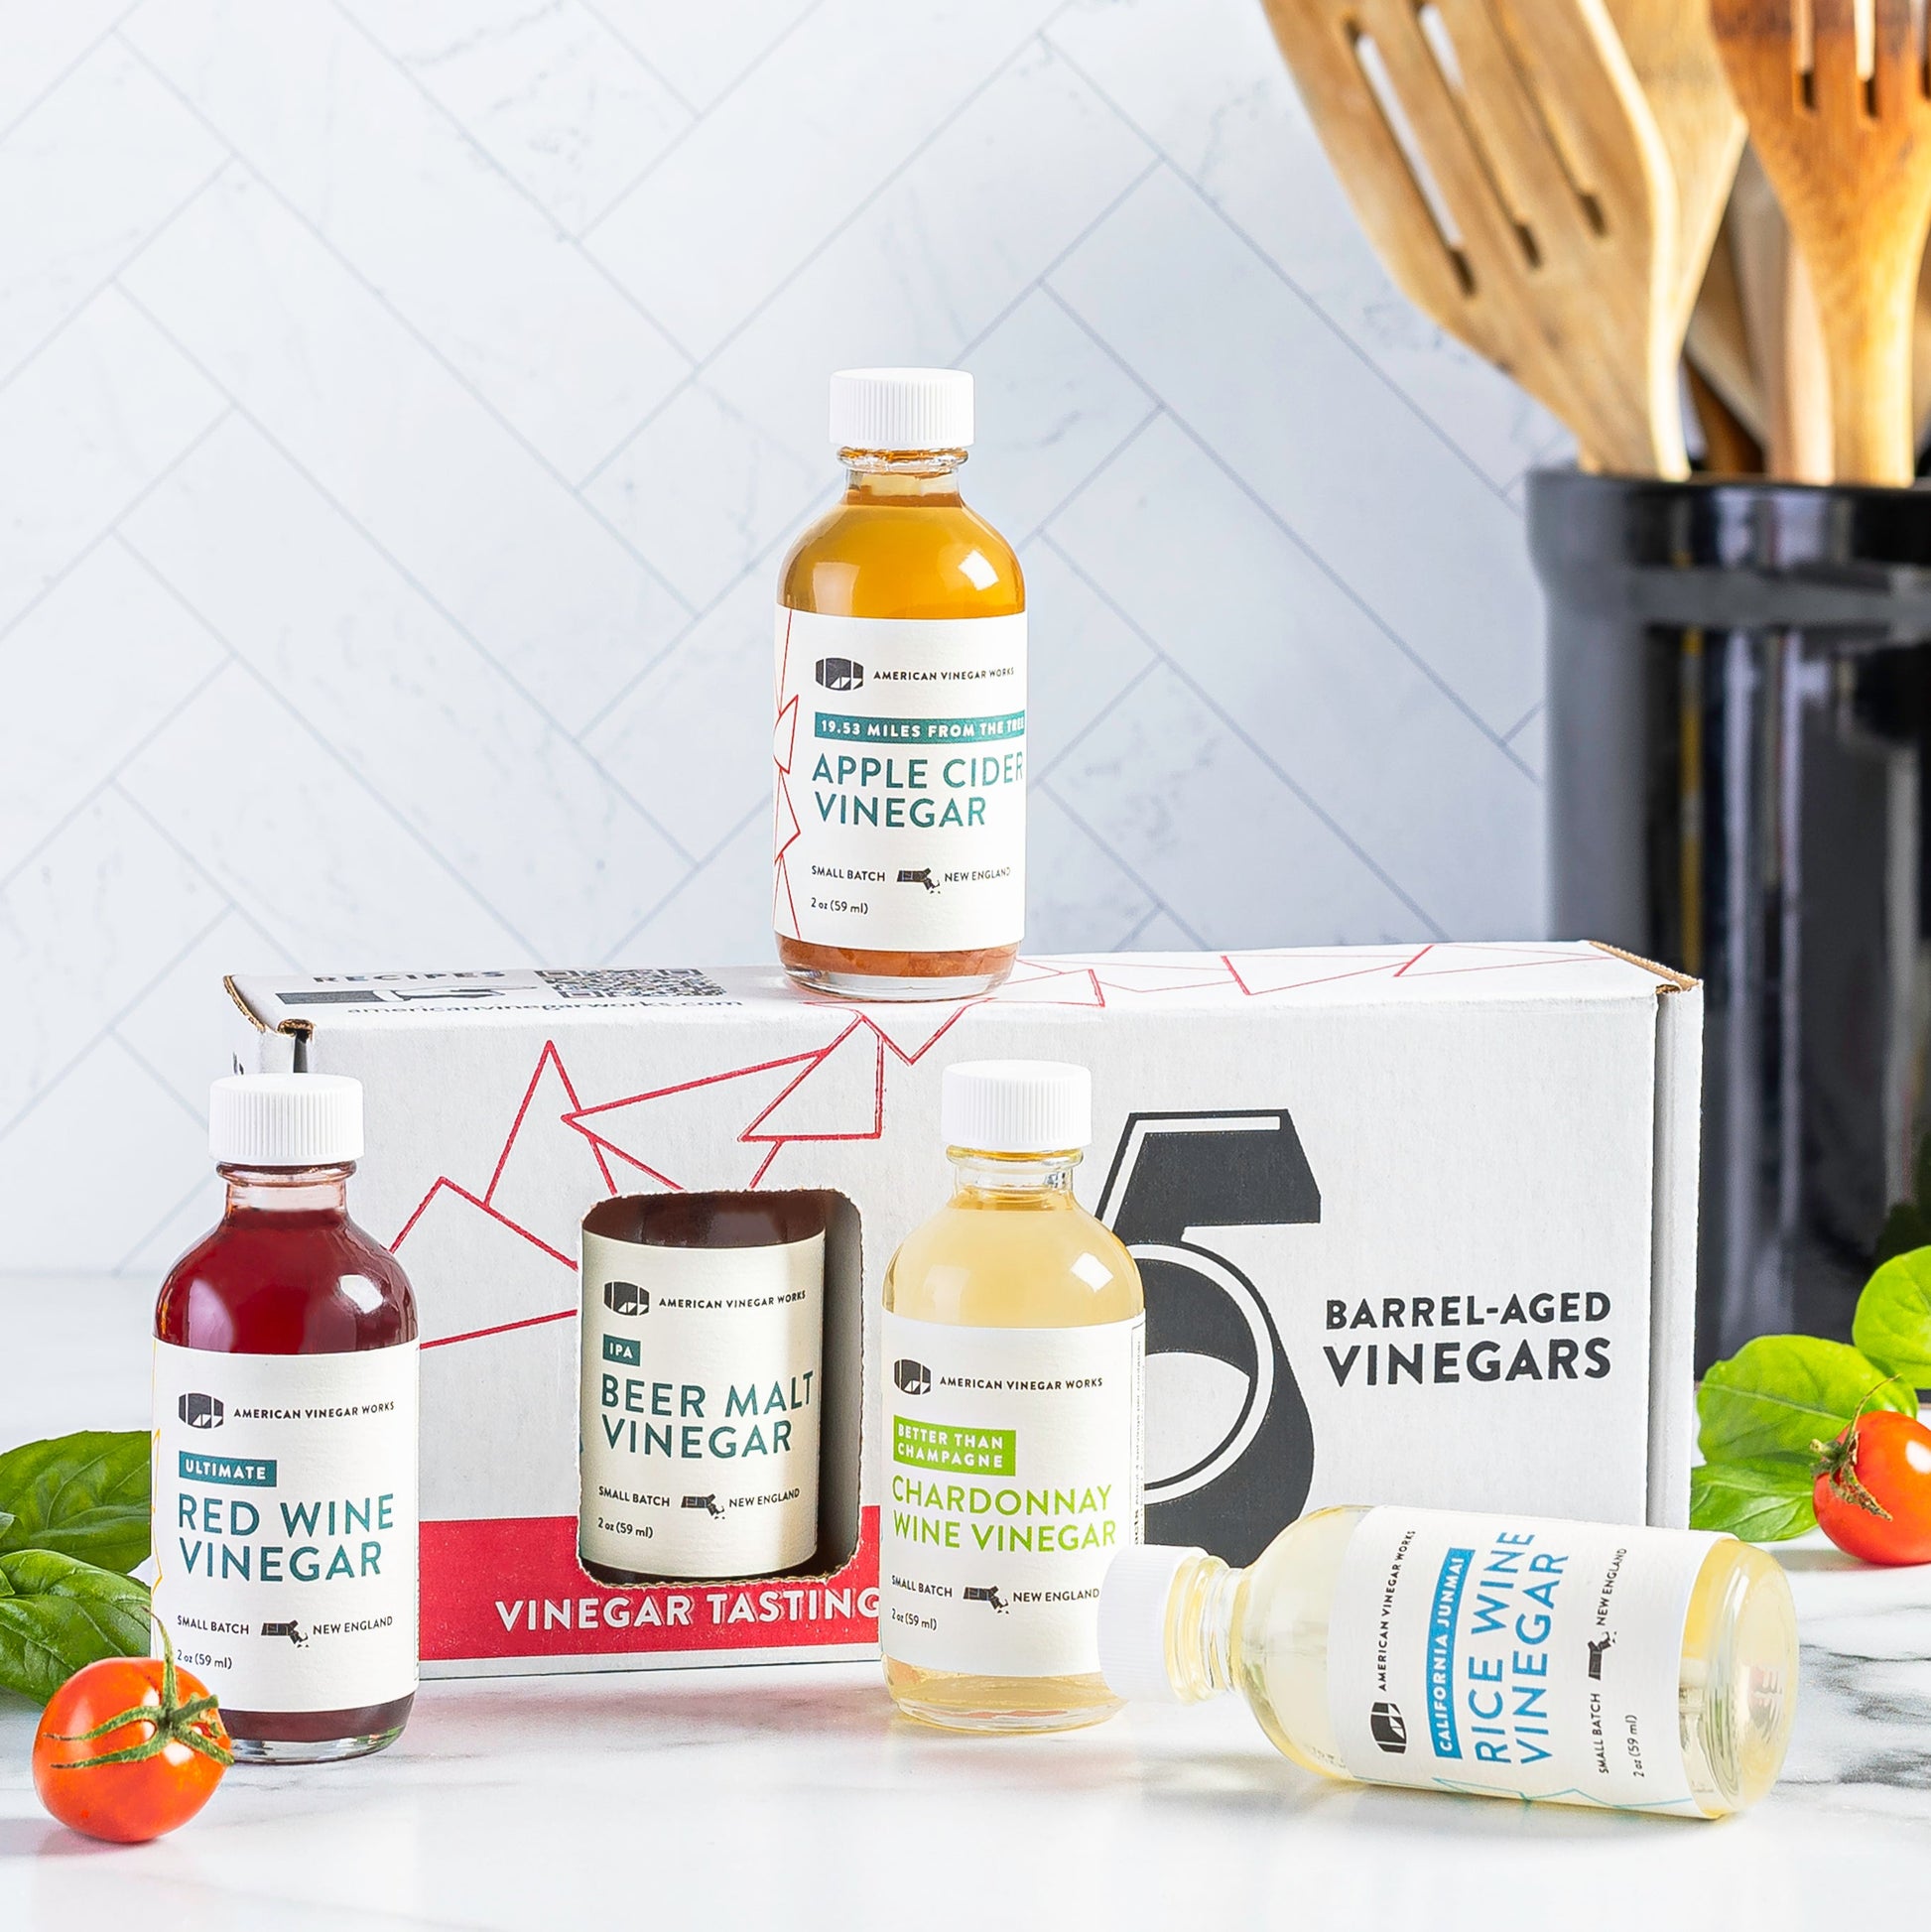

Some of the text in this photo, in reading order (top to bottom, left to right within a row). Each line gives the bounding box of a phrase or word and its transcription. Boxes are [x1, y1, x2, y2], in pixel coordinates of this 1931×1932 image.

[873, 667, 1015, 682] AMERICAN VINEGAR WORKS
[821, 717, 1025, 738] 19.53 MILES FROM THE TREE
[812, 750, 1024, 789] APPLE CIDER
[814, 791, 987, 829] VINEGAR
[811, 864, 886, 882] SMALL BATCH
[944, 865, 1011, 883] NEW ENGLAND
[811, 897, 816, 908] 2
[830, 898, 847, 912] (59
[849, 902, 869, 915] ml)
[313, 970, 506, 982] RECIPES
[347, 1000, 743, 1013] americanvinegarworks.com
[659, 1290, 806, 1309] AMERICAN VINEGAR WORKS
[1325, 1292, 1611, 1330] BARREL-AGED
[609, 1342, 633, 1359] IPA
[1322, 1337, 1612, 1387] VINEGARS
[601, 1370, 814, 1418] BEER MALT
[940, 1375, 1103, 1391] AMERICAN VINEGAR WORKS
[233, 1401, 395, 1420] AMERICAN VINEGAR WORKS
[601, 1413, 792, 1459] VINEGAR
[897, 1423, 1003, 1450] BETTER THAN
[897, 1442, 1003, 1469] CHAMPAGNE
[185, 1459, 267, 1481] ULTIMATE
[598, 1485, 671, 1507] SMALL BATCH
[728, 1487, 800, 1508] NEW ENGLAND
[892, 1475, 1112, 1517] CHARDONNAY
[178, 1492, 394, 1538] RED WINE
[597, 1517, 603, 1529] 2
[616, 1521, 633, 1536] (59
[635, 1525, 654, 1539] ml)
[893, 1509, 1116, 1553] WINE VINEGAR
[179, 1536, 382, 1583] VINEGAR
[891, 1575, 954, 1599] SMALL BATCH
[1013, 1588, 1099, 1603] NEW ENGLAND
[1596, 1547, 1628, 1626] NEW ENGLAND
[494, 1587, 880, 1632] VINEGAR TASTING
[891, 1608, 896, 1620] 2
[905, 1612, 920, 1627] (59
[921, 1618, 938, 1630] ml)
[1377, 1530, 1416, 1692] AMERICAN VINEGAR WORKS
[177, 1614, 250, 1634] SMALL BATCH
[313, 1615, 393, 1634] NEW ENGLAND
[1431, 1557, 1465, 1752] CALIFORNIA JUNMAI
[1467, 1531, 1536, 1764] RICE WINE
[177, 1649, 183, 1661] 2
[194, 1652, 211, 1667] (59
[213, 1656, 232, 1670] ml)
[1511, 1554, 1569, 1764] VINEGAR
[1590, 1692, 1609, 1774] SMALL BATCH
[1623, 1715, 1638, 1736] ml)
[1626, 1736, 1642, 1756] (59
[1635, 1758, 1644, 1768] oz
